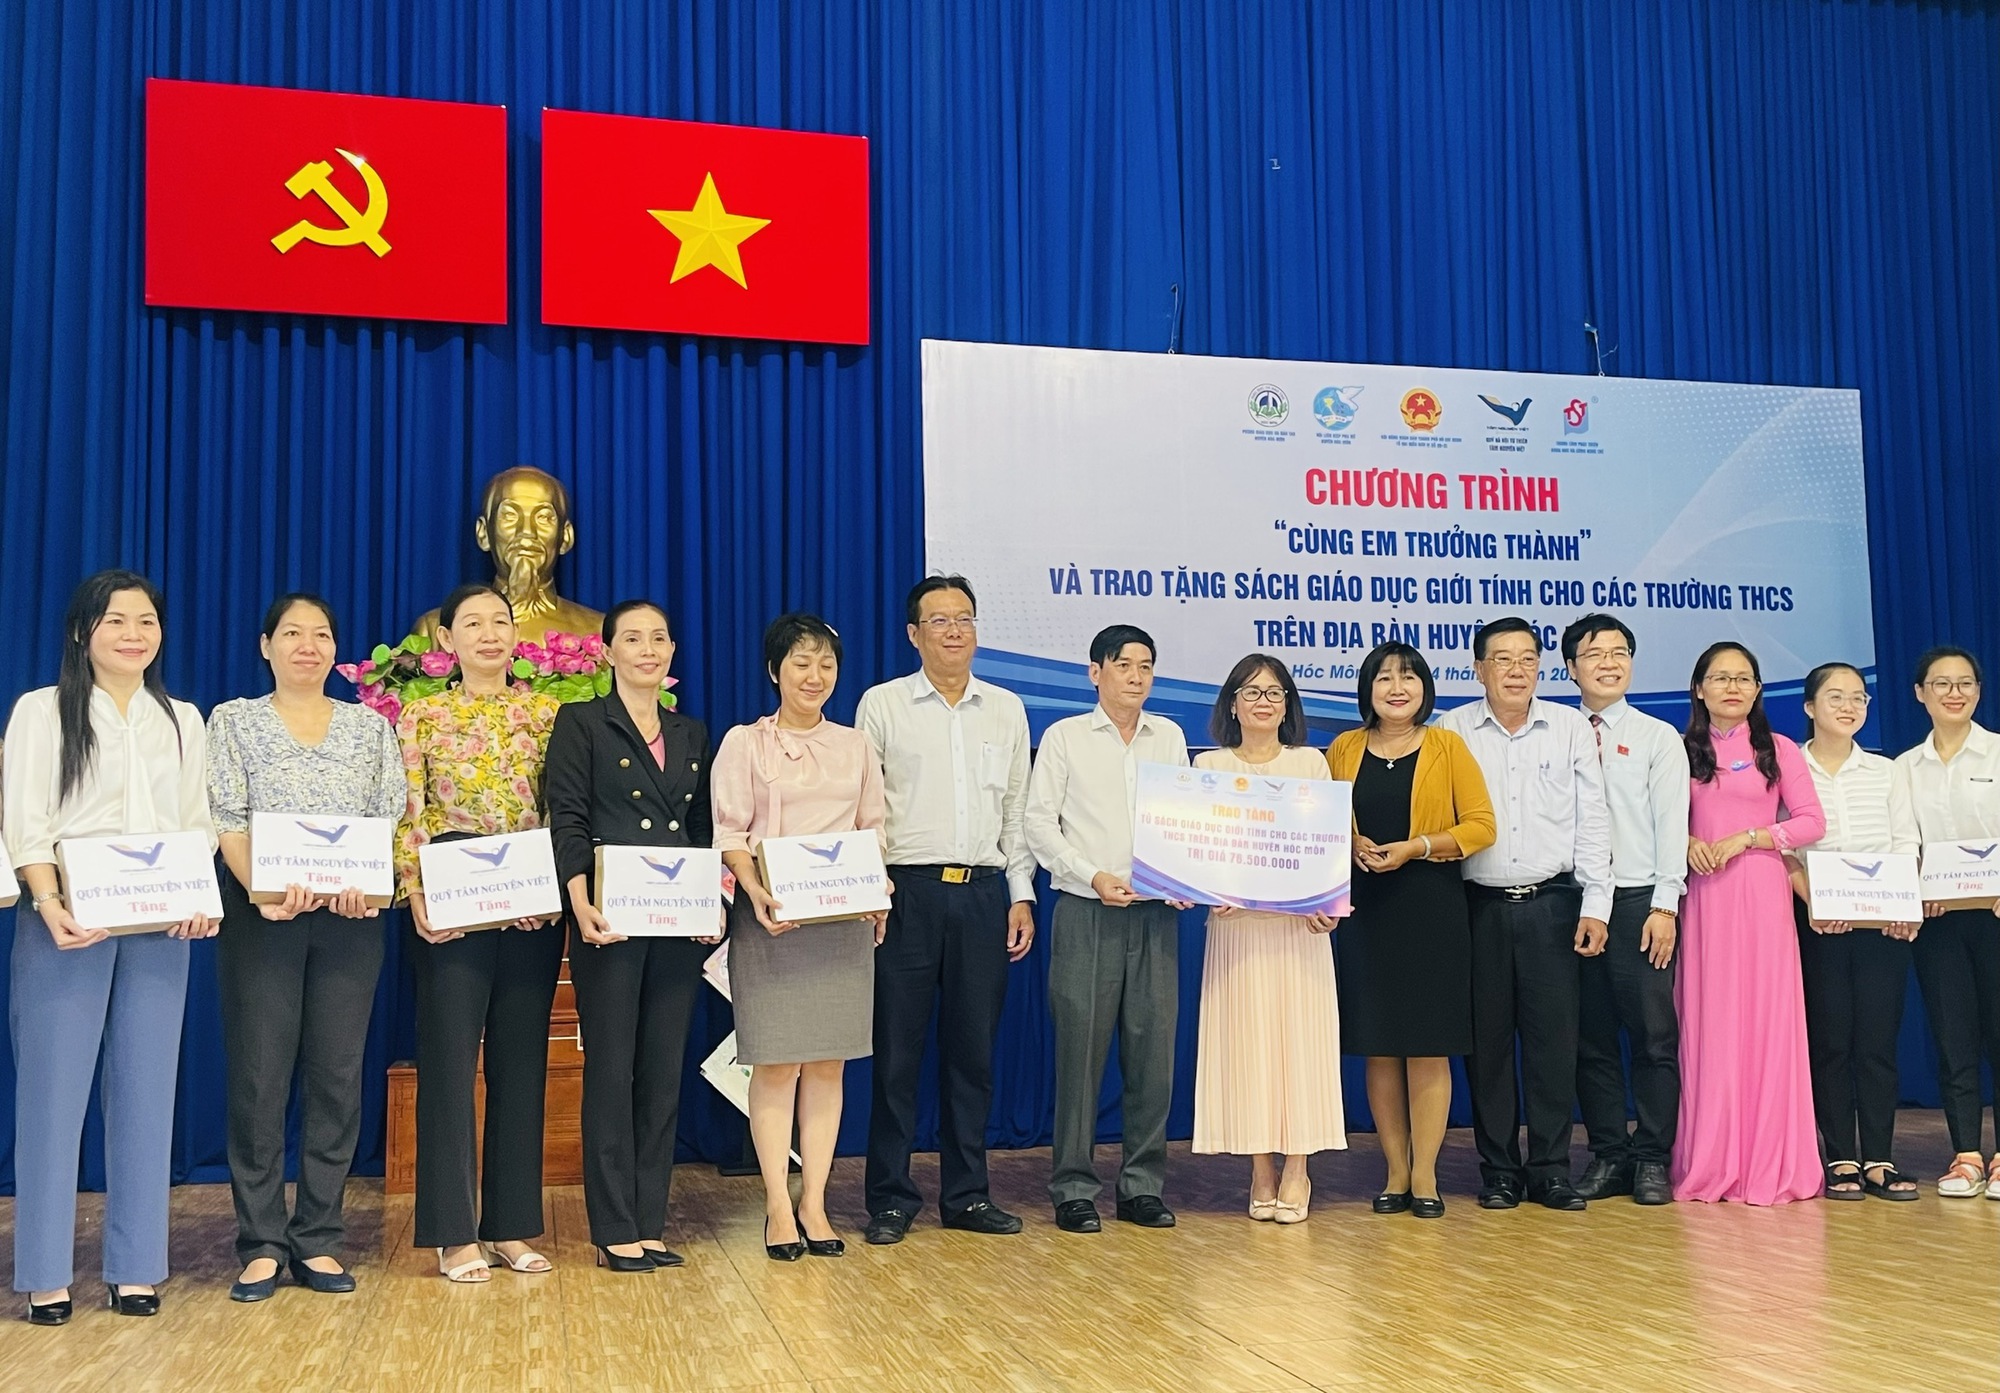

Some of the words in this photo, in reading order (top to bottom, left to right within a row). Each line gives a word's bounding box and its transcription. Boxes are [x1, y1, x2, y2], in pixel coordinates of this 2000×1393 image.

[1305, 468, 1448, 510] CHƯƠNG
[1458, 468, 1559, 512] TRÌNH
[1361, 530, 1397, 557] EM
[1404, 524, 1497, 559] TRƯỞNG
[1049, 563, 1083, 595] VÀ
[1090, 569, 1153, 597] TRAO
[1160, 565, 1226, 604] TẶNG
[1234, 567, 1299, 601] SÁCH
[1307, 570, 1363, 602] GIÁO
[1370, 576, 1417, 609] DỤC
[1426, 573, 1472, 605] GIỚI
[1479, 573, 1532, 605] TÍNH
[1539, 580, 1585, 607] CHO
[1592, 576, 1637, 608] CÁC
[1643, 577, 1732, 610] TRƯỜNG
[1738, 585, 1794, 612] THCS
[1253, 615, 1316, 647] TRÊN
[1323, 621, 1364, 654] ĐỊA
[1371, 617, 1420, 649] BÀN
[1531, 620, 1557, 651] ÓC
[1292, 663, 1324, 679] Hóc
[1212, 804, 1241, 819] TRAO
[1163, 831, 1185, 842] THCS
[1270, 830, 1287, 840] CHO
[258, 855, 282, 866] QUỸ
[284, 855, 310, 867] TÂM
[361, 858, 387, 870] VIỆT
[304, 872, 342, 885] Tặng
[775, 881, 795, 895] QUỸ
[797, 879, 818, 891] TÂM
[859, 873, 881, 885] VIỆT
[76, 886, 101, 901] QUỸ
[104, 884, 131, 897] TÂM
[184, 878, 211, 891] VIỆT
[430, 888, 452, 903] QUỸ
[455, 886, 479, 898] TÂM
[527, 875, 551, 887] VIỆT
[1836, 888, 1857, 898] TÂM
[127, 901, 168, 914] Tặng
[475, 899, 512, 913] Tặng
[607, 895, 628, 908] QUỸ
[630, 895, 651, 907] TÂM
[694, 896, 716, 909] VIỆT
[816, 895, 848, 907] Tặng
[1852, 902, 1882, 914] Tặng
[647, 913, 678, 927] Tặng
